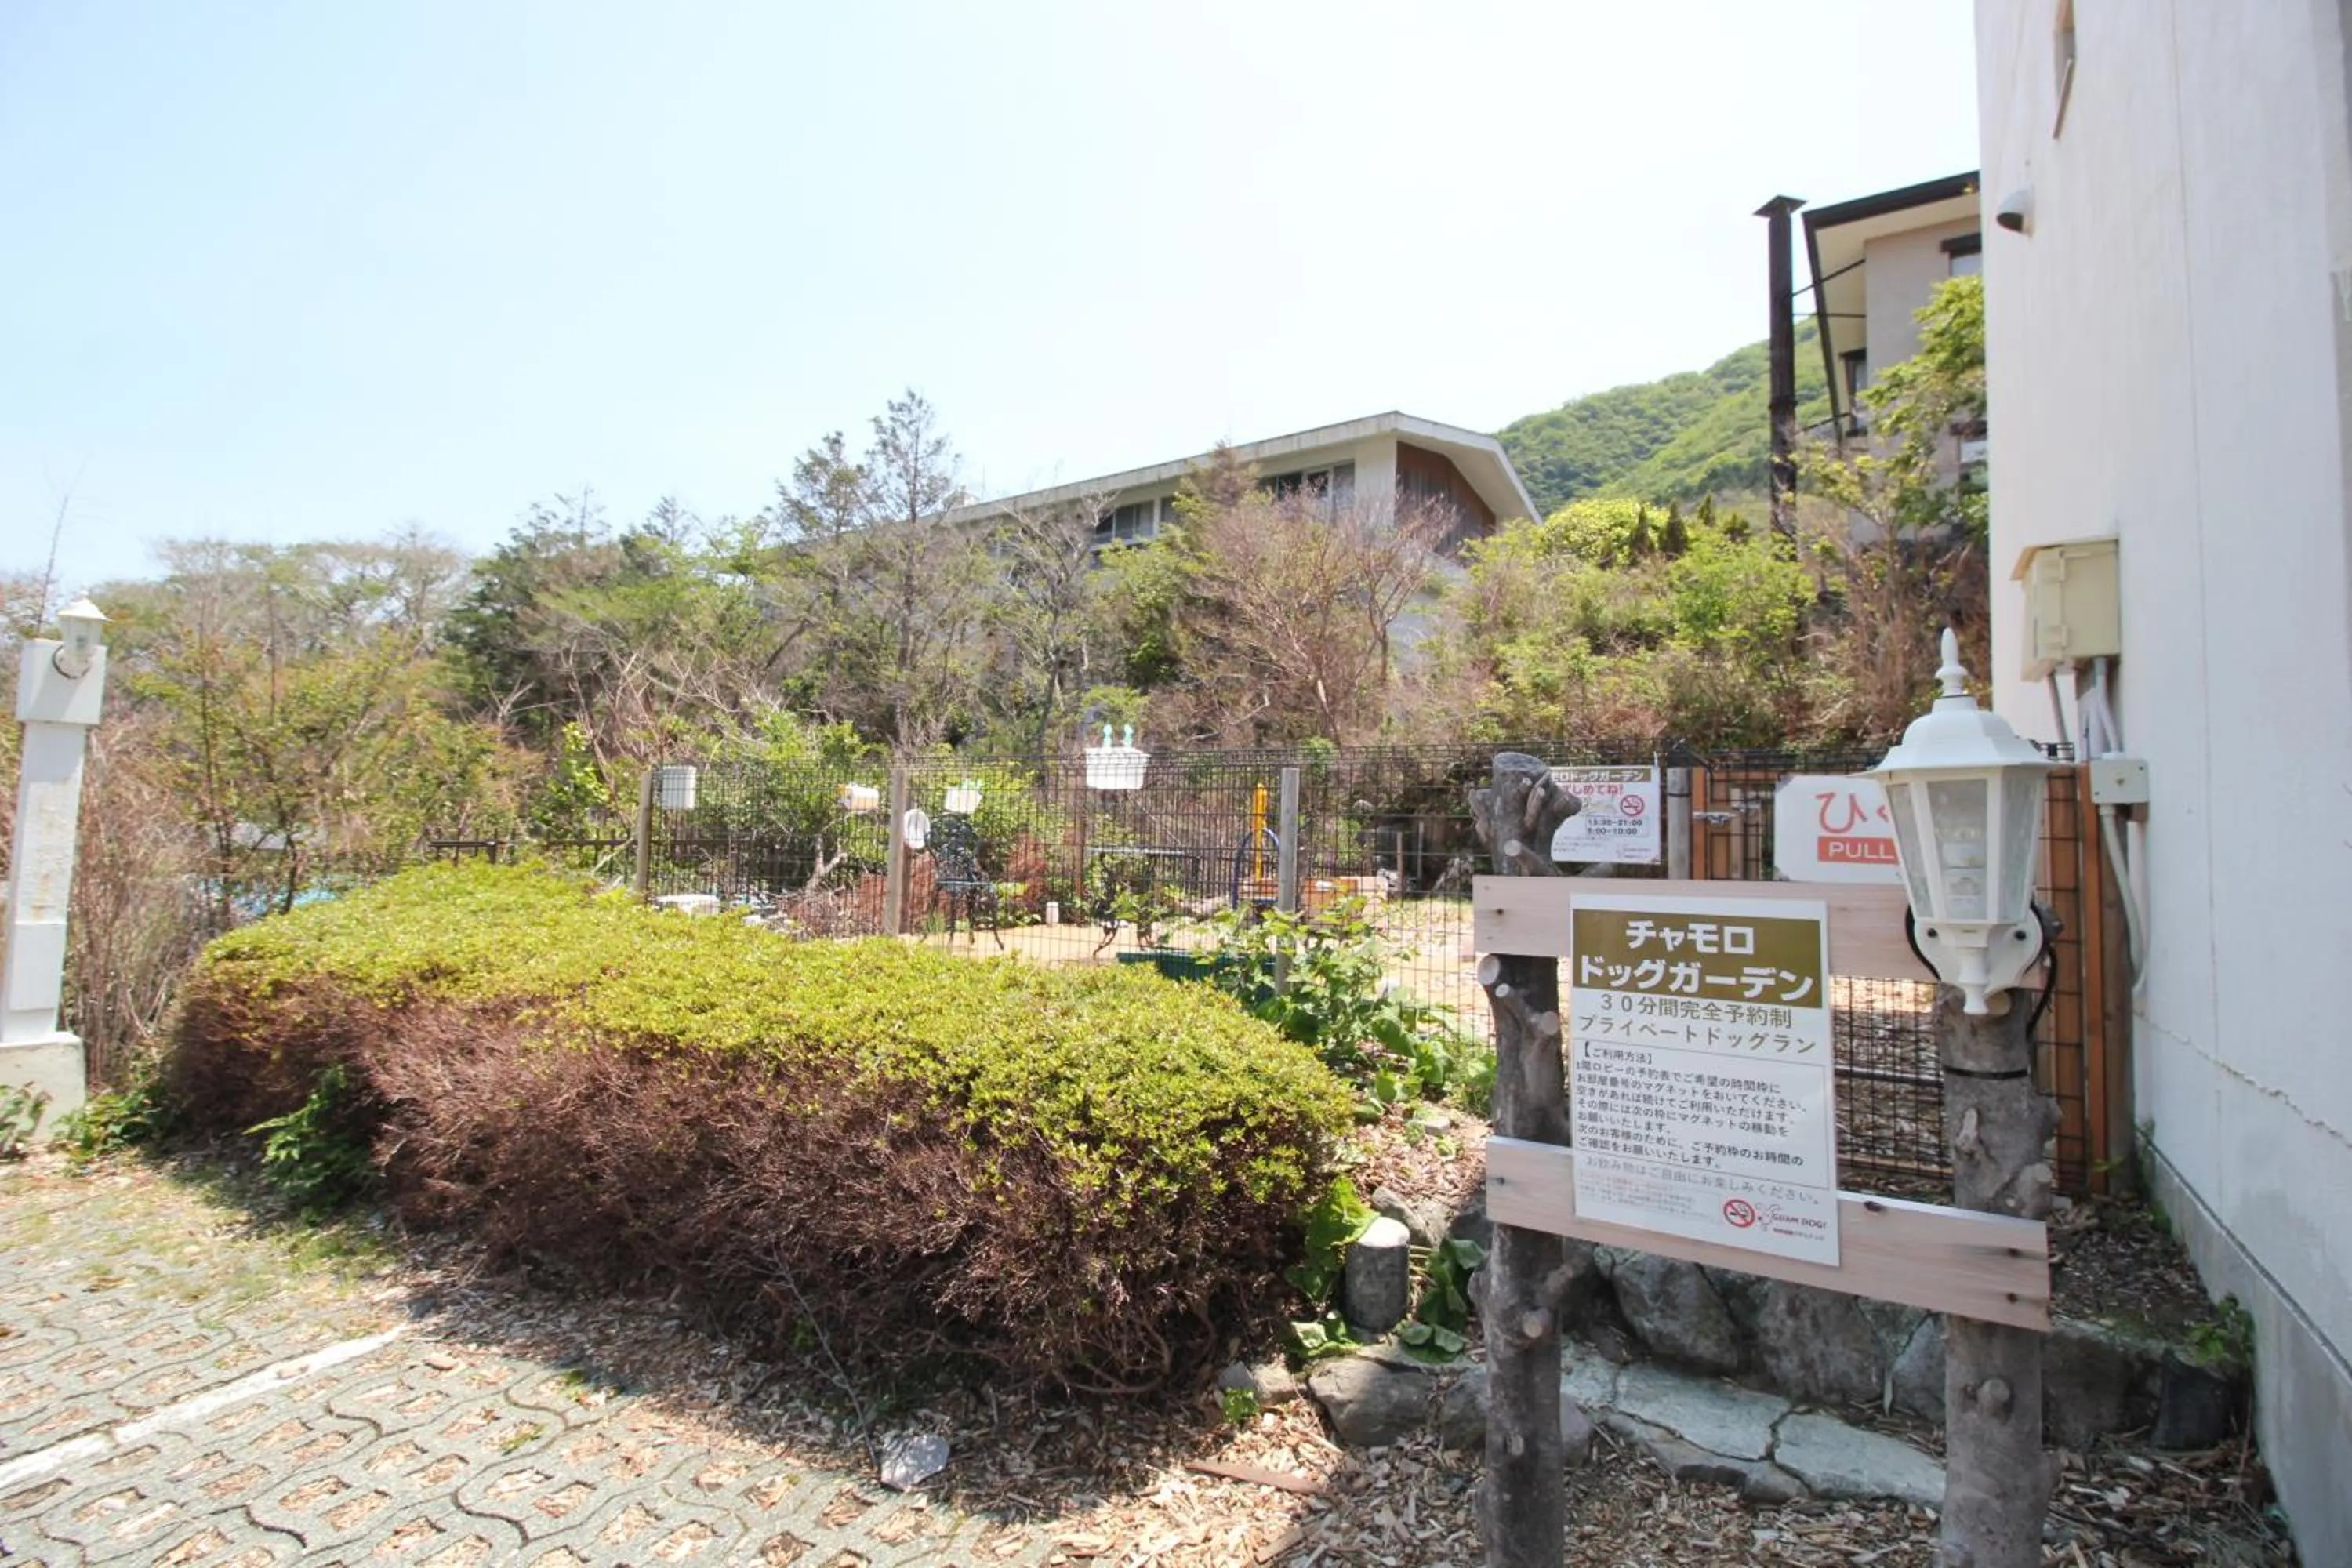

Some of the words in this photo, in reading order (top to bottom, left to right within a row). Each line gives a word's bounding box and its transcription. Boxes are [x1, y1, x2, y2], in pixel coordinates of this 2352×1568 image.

[1828, 842, 1895, 859] PULL
[1625, 920, 1755, 955] チャモロ
[1580, 954, 1814, 1002] ドッグガーデン
[1600, 993, 1792, 1029] 30分間完全予約制
[1577, 1014, 1817, 1054] プライベートドッグラン
[1584, 1040, 1653, 1065] 【ご利用方法】
